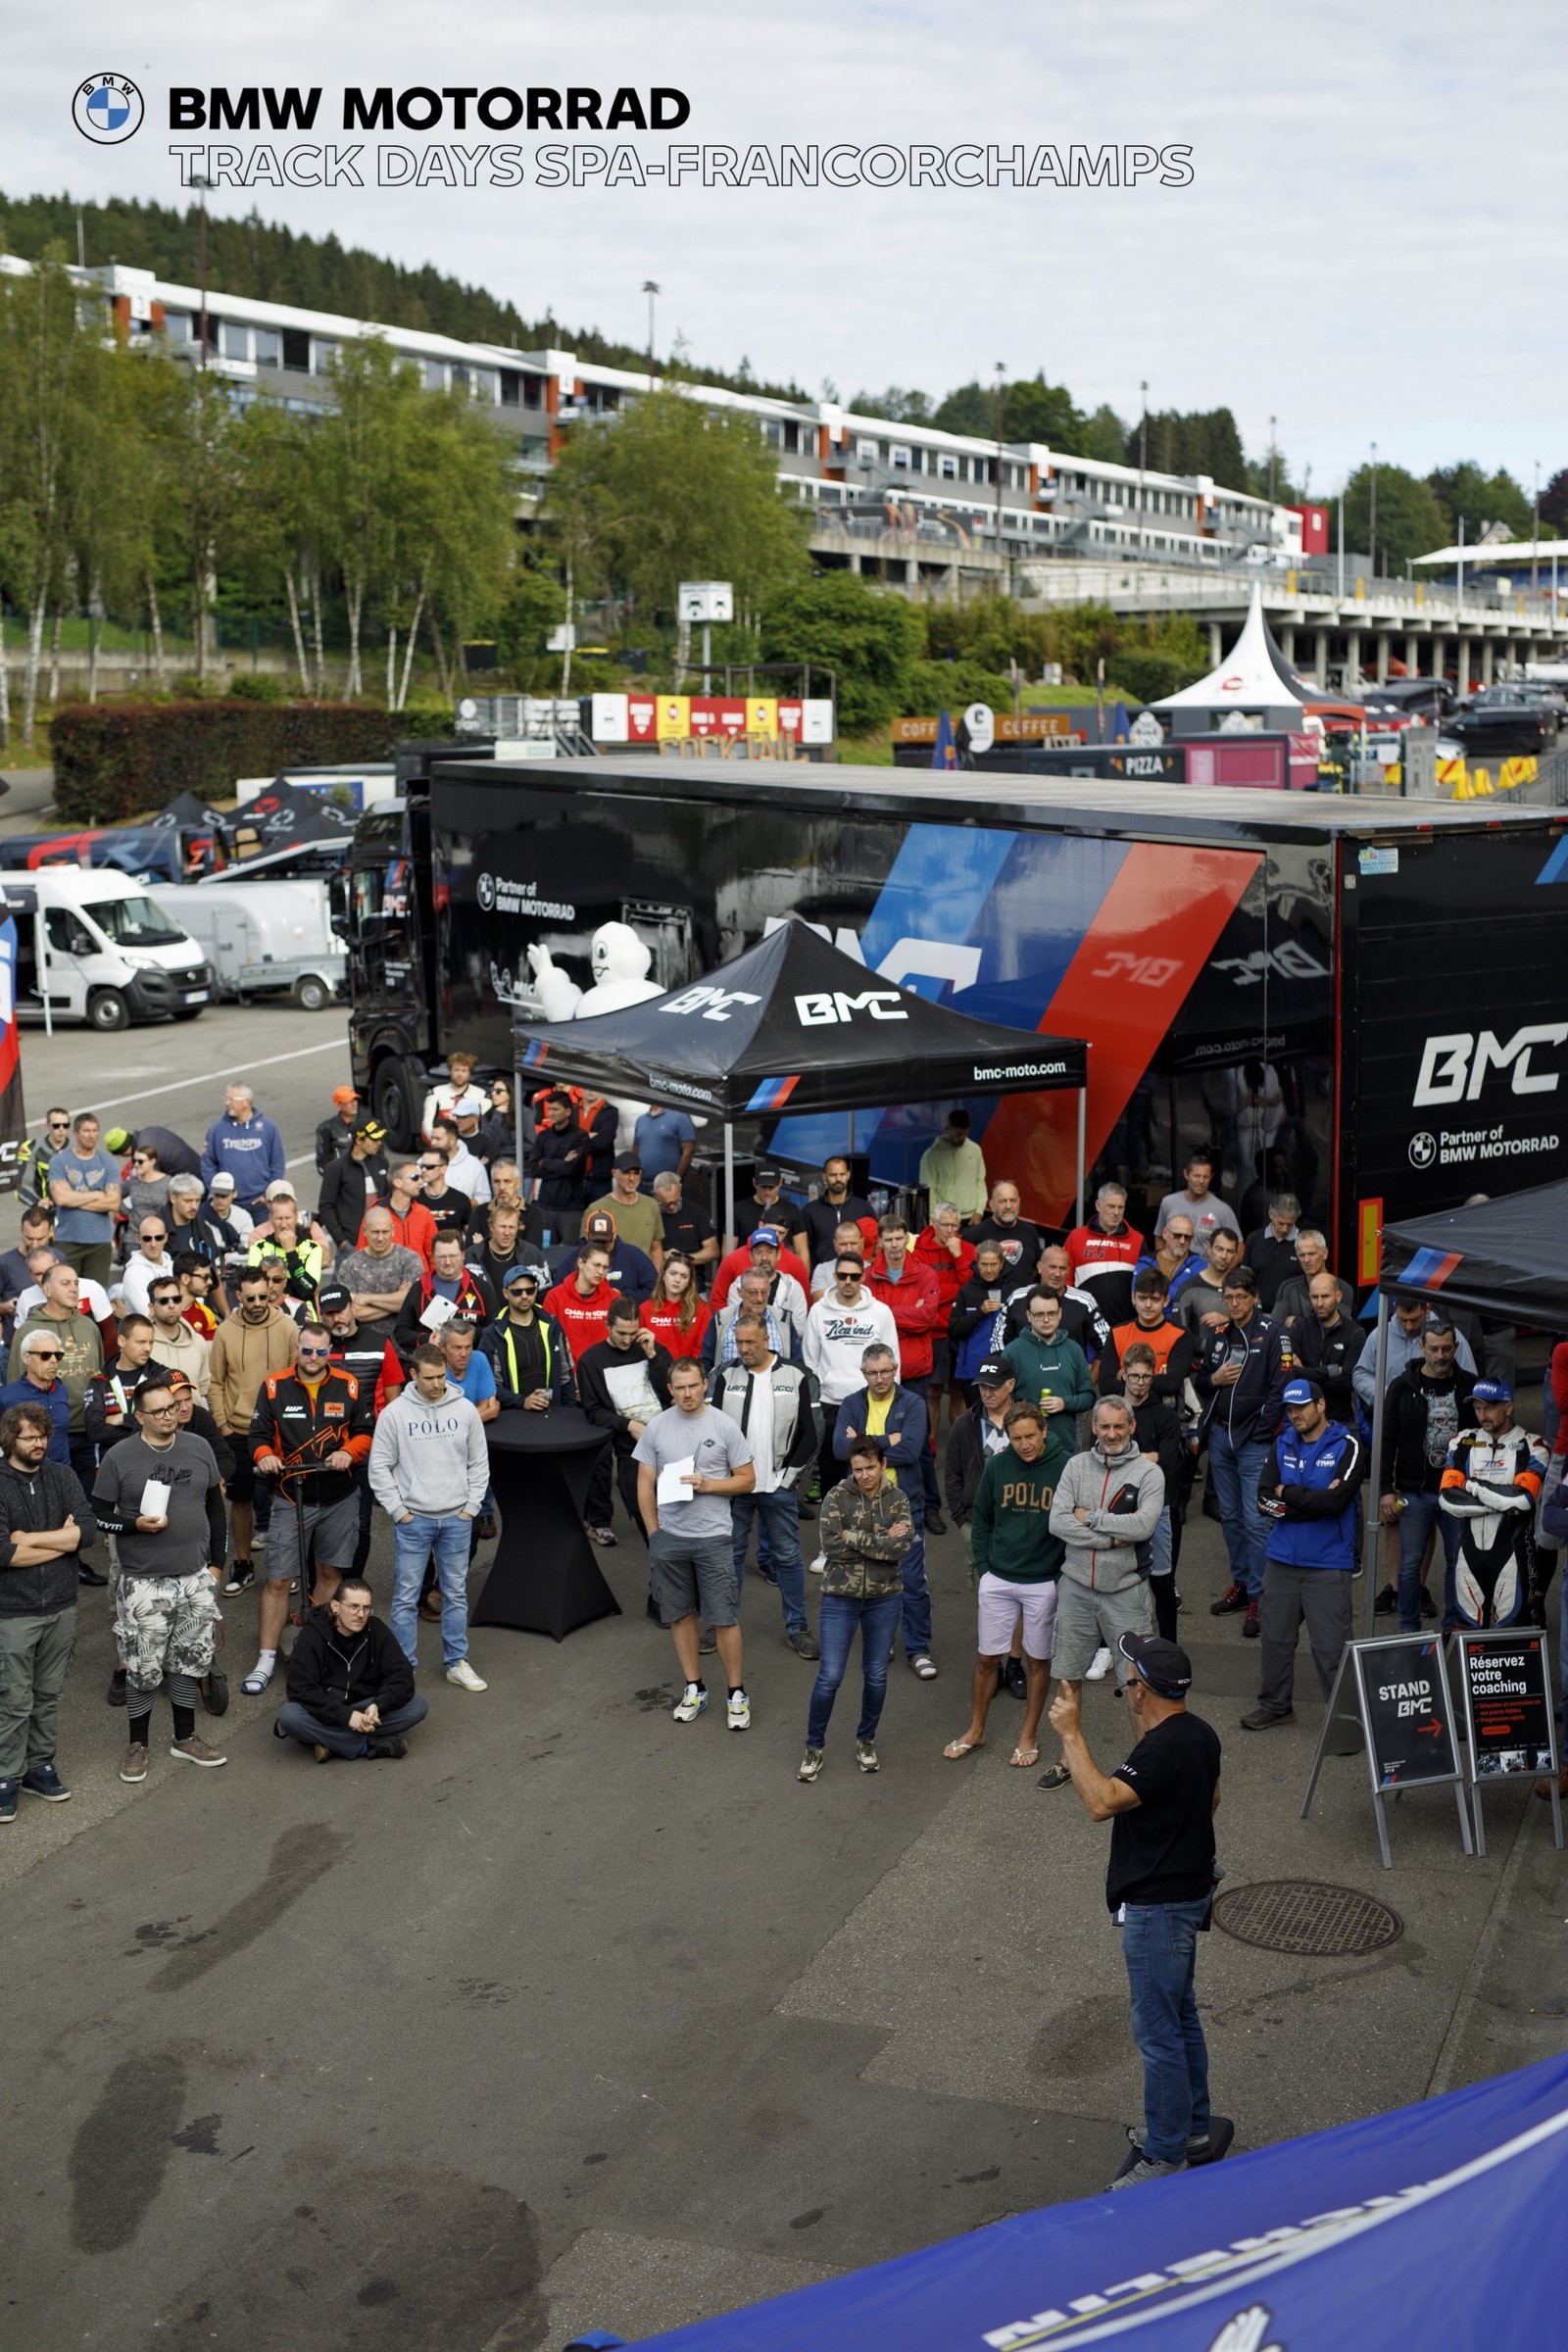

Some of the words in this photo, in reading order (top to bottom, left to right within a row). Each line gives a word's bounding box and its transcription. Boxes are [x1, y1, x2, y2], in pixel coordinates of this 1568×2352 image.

[1003, 718, 1058, 736] COFFEE
[1126, 756, 1163, 776] PIZZA
[496, 877, 525, 896] Partner
[526, 882, 537, 897] of
[496, 896, 520, 912] BMW
[521, 899, 576, 921] MOTORRAD
[658, 986, 762, 1022] BMC
[794, 992, 909, 1027] BMC
[973, 1062, 1067, 1081] bmc-moto.com
[1413, 1022, 1568, 1107] BMC
[649, 1073, 712, 1102] bmc-moto.com
[1440, 1131, 1489, 1147] Partner
[1490, 1125, 1503, 1141] of
[1440, 1149, 1475, 1164] BMW
[1479, 1135, 1559, 1160] MOTORRAD
[409, 1417, 459, 1437] POLO
[1001, 1482, 1054, 1511] POLO
[1469, 1655, 1525, 1669] Réservez
[1471, 1670, 1502, 1682] votre
[1379, 1680, 1431, 1701] STAND
[1472, 1681, 1527, 1695] coaching
[1397, 1696, 1432, 1717] BMC
